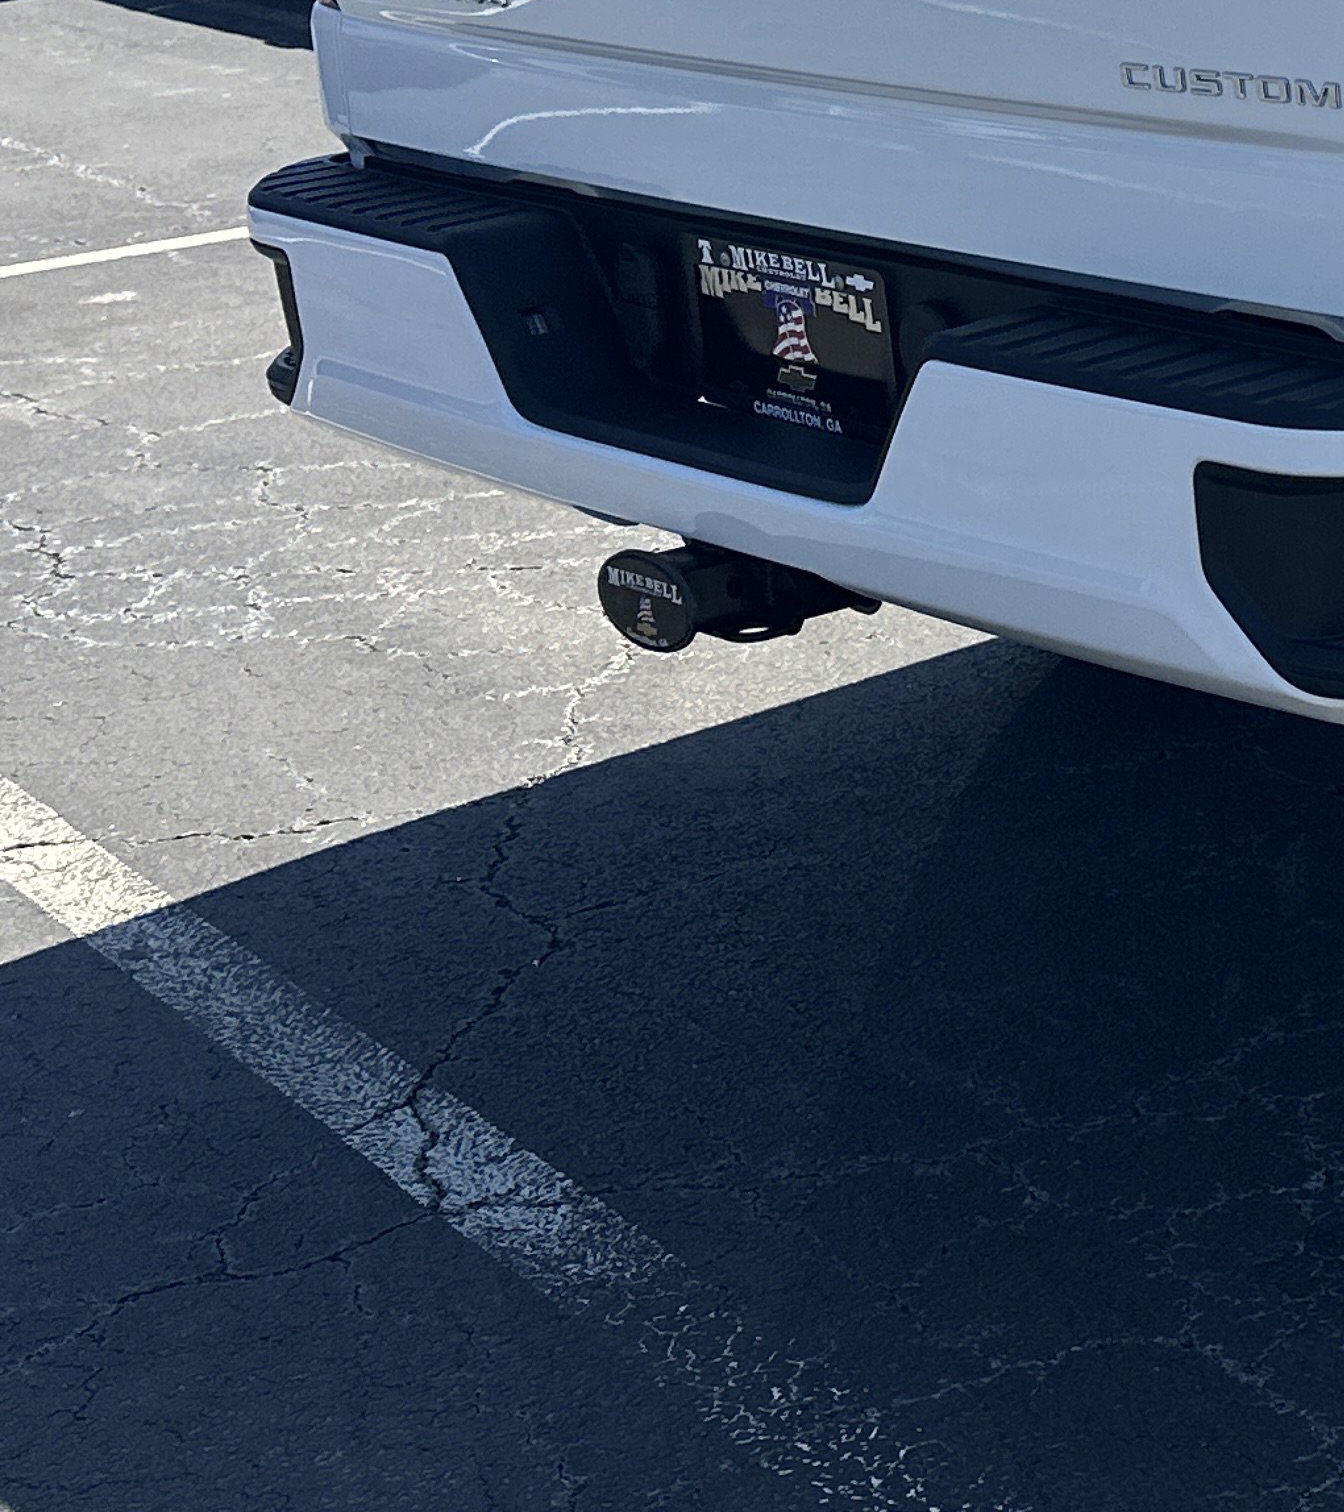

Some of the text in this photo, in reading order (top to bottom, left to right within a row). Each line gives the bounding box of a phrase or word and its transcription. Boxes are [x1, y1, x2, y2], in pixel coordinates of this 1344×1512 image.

[1119, 61, 1343, 110] CUSTOM
[728, 245, 780, 271] MIKE
[782, 255, 836, 289] BELL
[698, 264, 882, 333] MIKE BELL
[826, 417, 843, 434] GA
[606, 565, 645, 588] MIKE
[645, 577, 683, 606] BELL
